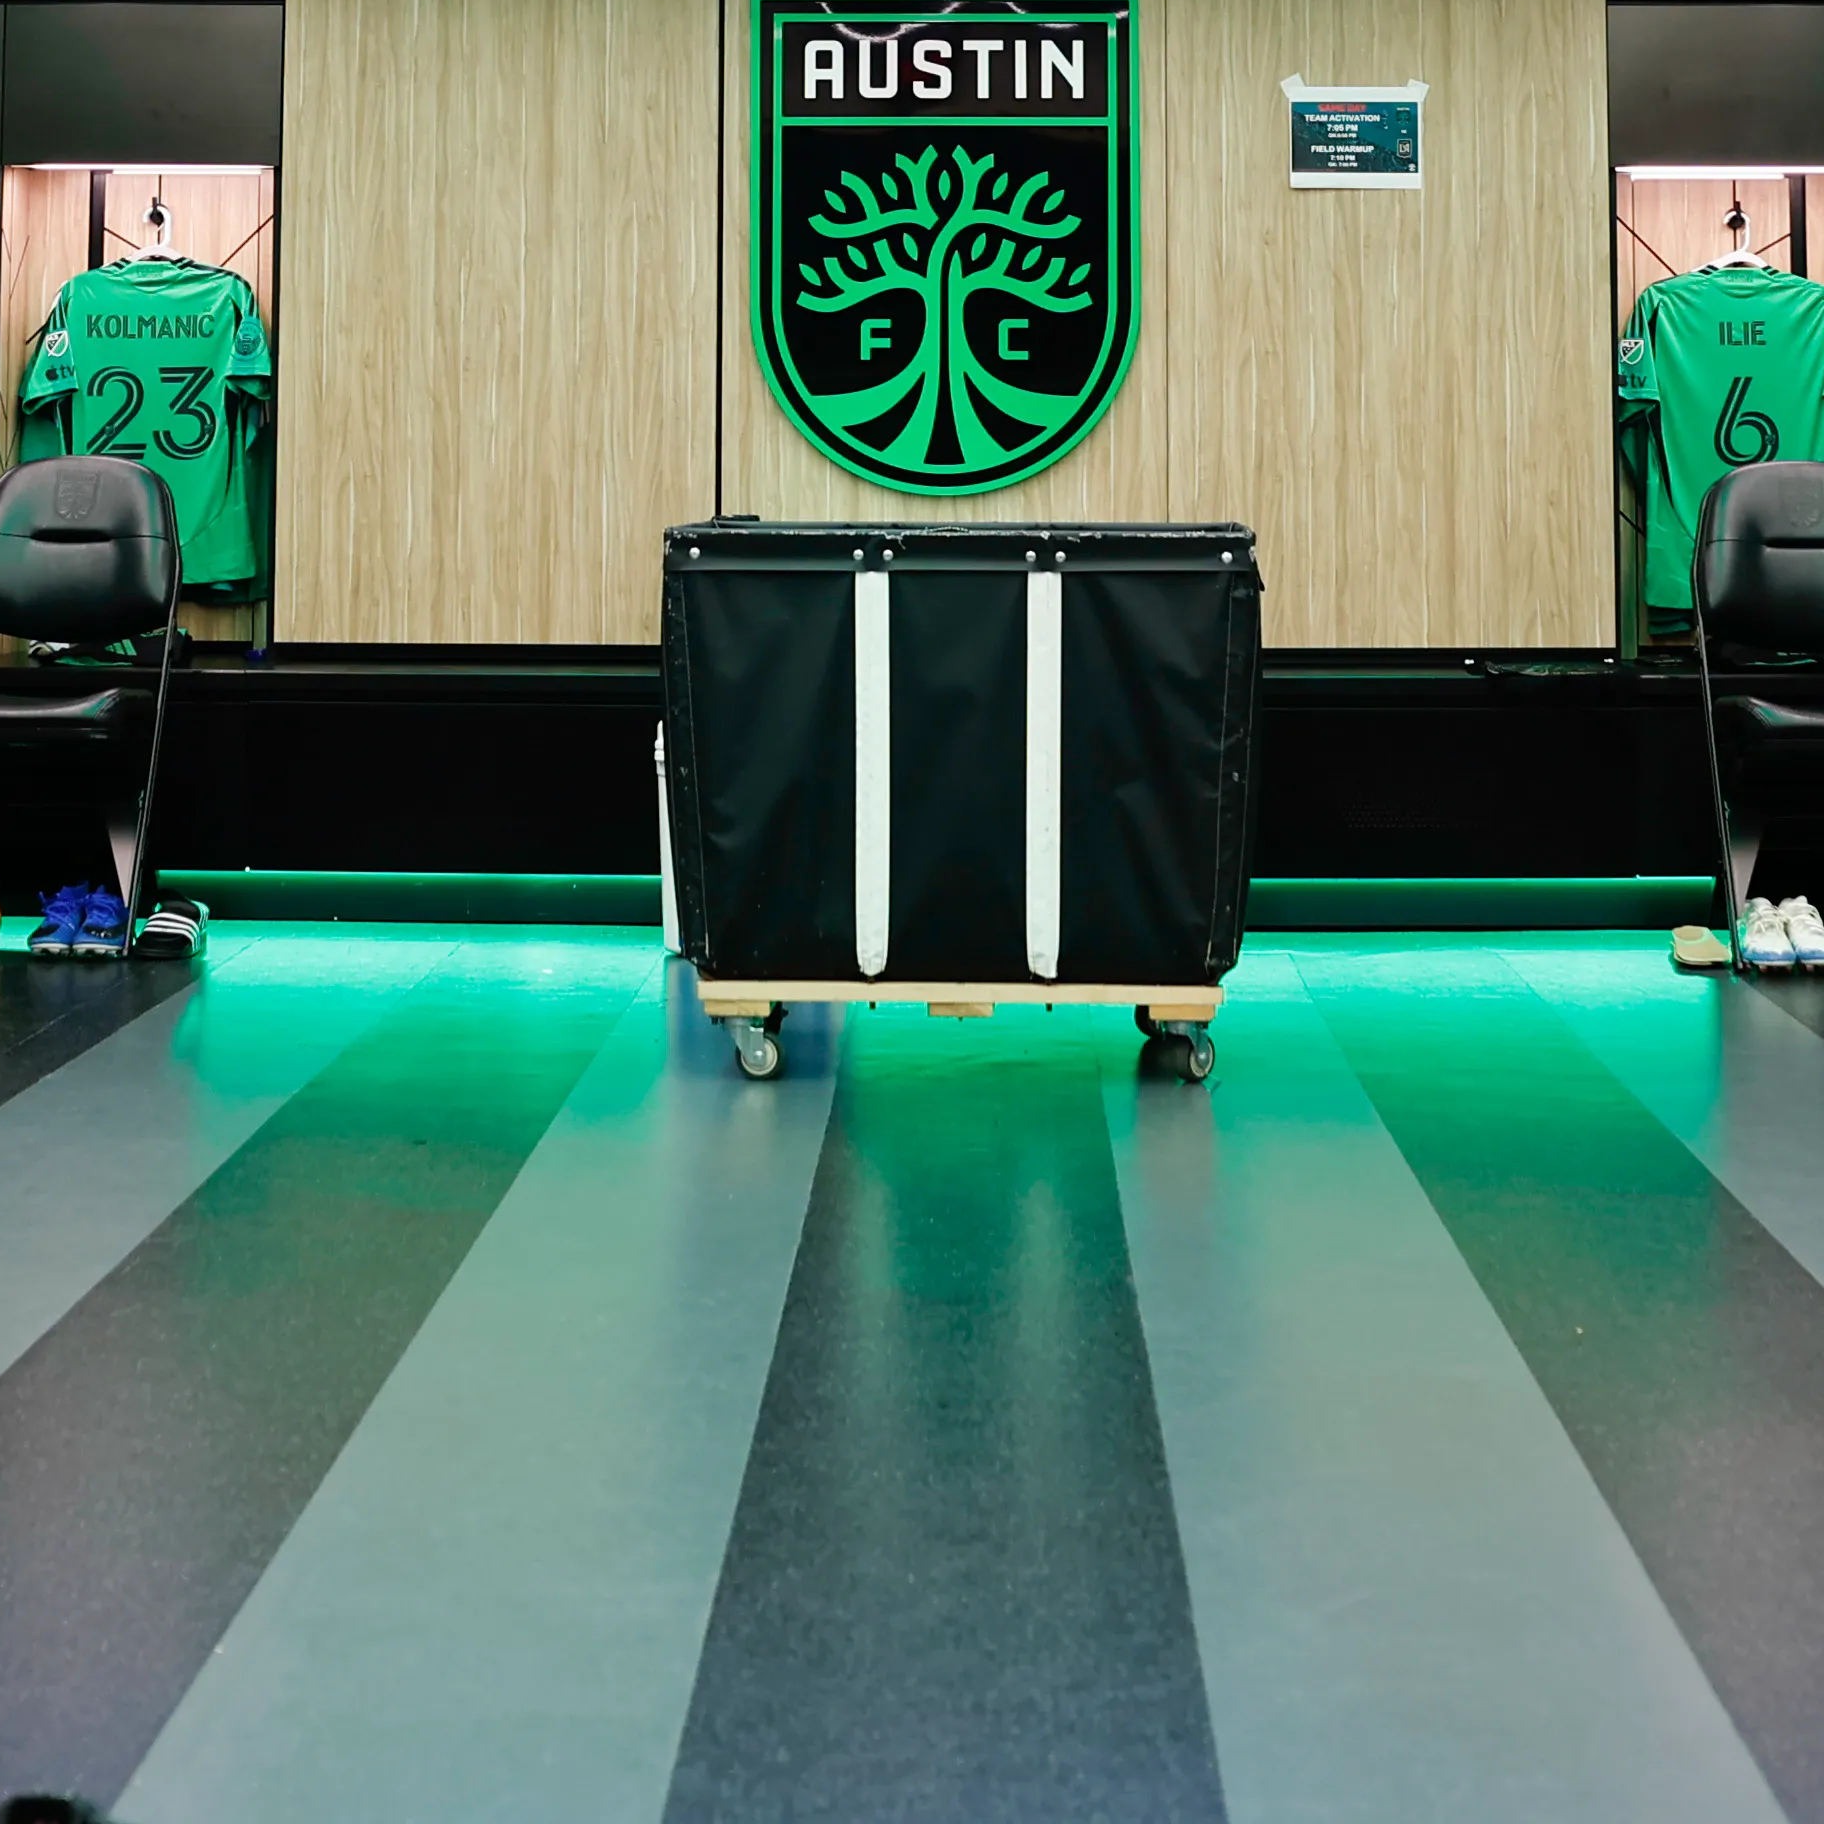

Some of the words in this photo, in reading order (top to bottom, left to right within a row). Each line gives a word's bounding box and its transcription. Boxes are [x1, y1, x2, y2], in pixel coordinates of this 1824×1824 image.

[803, 39, 1085, 99] AUSTIN
[1304, 114, 1328, 122] TEAM
[1329, 114, 1381, 122] ACTIVATION
[1310, 145, 1335, 153] FIELD
[1336, 145, 1375, 153] WARMUP
[860, 318, 892, 360] F
[998, 318, 1029, 360] C
[1718, 320, 1767, 346] ILIE
[85, 365, 217, 462] 23
[1713, 376, 1780, 467] 6
